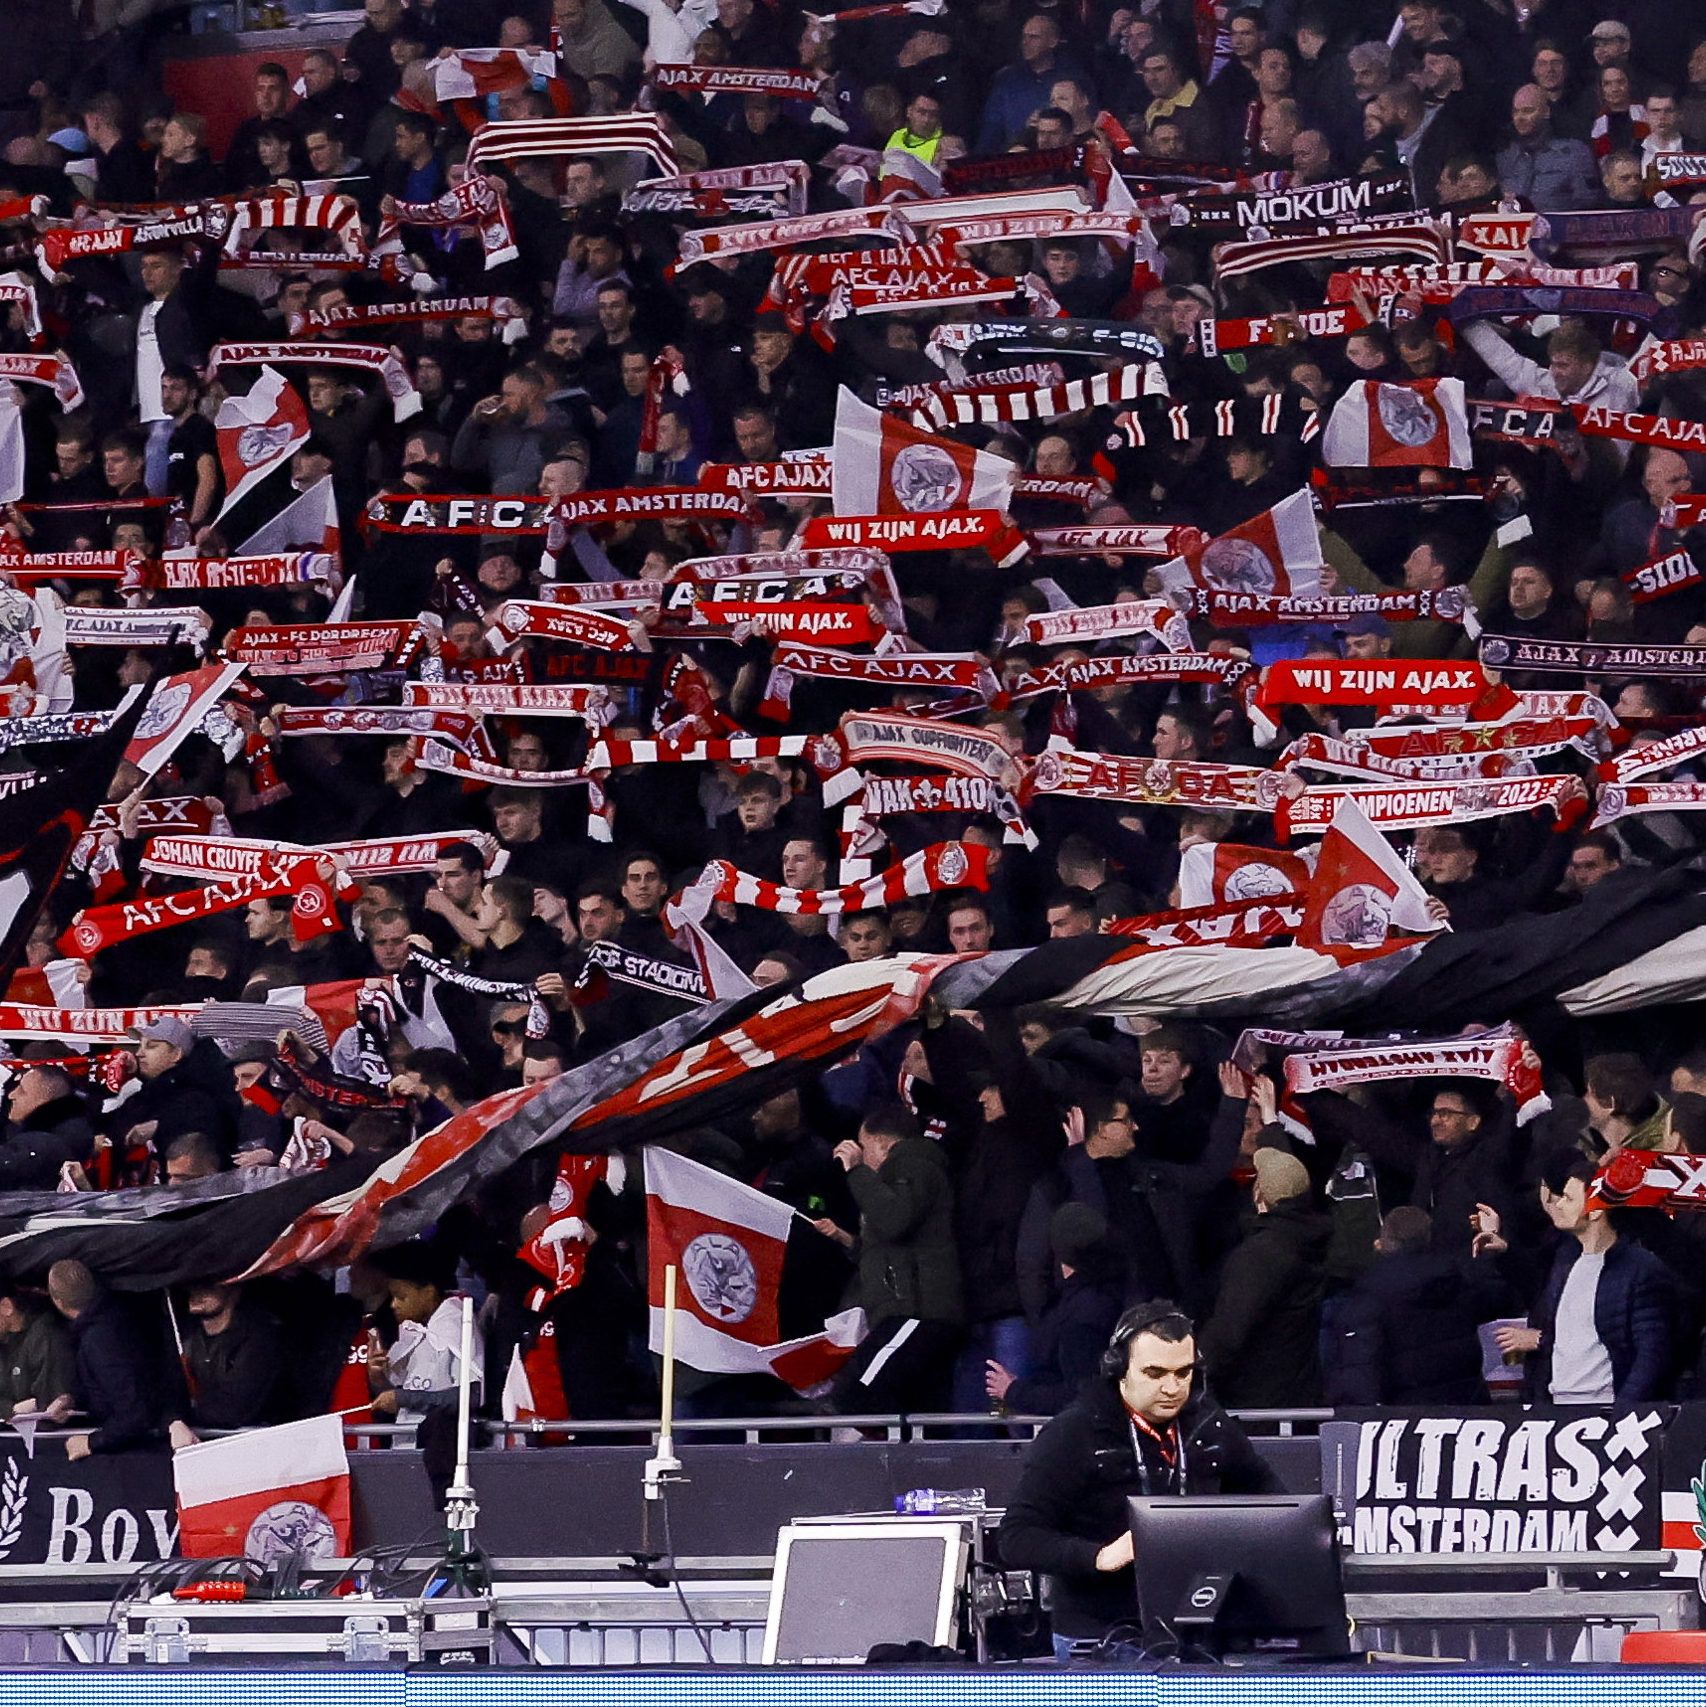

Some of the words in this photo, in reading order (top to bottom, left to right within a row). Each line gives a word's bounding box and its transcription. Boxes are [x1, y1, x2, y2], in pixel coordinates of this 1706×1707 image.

[657, 70, 703, 87] AJAX
[707, 73, 820, 93] AMSTERDAM
[1237, 181, 1370, 226] MOKUM
[831, 268, 881, 286] AFC
[888, 269, 953, 286] AJAX
[309, 307, 360, 325] AJAX
[373, 297, 490, 317] AMSTERDAM
[1583, 412, 1643, 434] AFC
[727, 465, 769, 488] AFC
[774, 463, 832, 487] AJAX
[827, 523, 860, 542] WIJ
[869, 521, 916, 542] ZIJN
[922, 518, 986, 538] AJAX.
[24, 550, 116, 567] AMSTERDAM
[1216, 595, 1269, 613] AJAX
[1278, 593, 1416, 614] AMSTERDAM
[242, 632, 278, 646] AJAX
[291, 630, 308, 642] FC
[310, 627, 399, 642] DORDRECHT
[784, 652, 851, 673] AFC
[865, 660, 957, 680] AJAX
[1518, 645, 1581, 663] AJAX
[1070, 661, 1111, 683] AJAX
[1121, 654, 1231, 675] AMSTERDAM
[1292, 669, 1332, 693] WIJ
[1340, 669, 1395, 695] ZIJN
[1402, 670, 1476, 691] AJAX.
[873, 725, 906, 743] AJAX
[944, 776, 992, 813] 410
[1496, 780, 1542, 807] 2022
[151, 840, 203, 865] JOHAN
[207, 846, 262, 872] CRUYFF
[122, 896, 196, 931] AFC
[202, 868, 292, 910] AJAX
